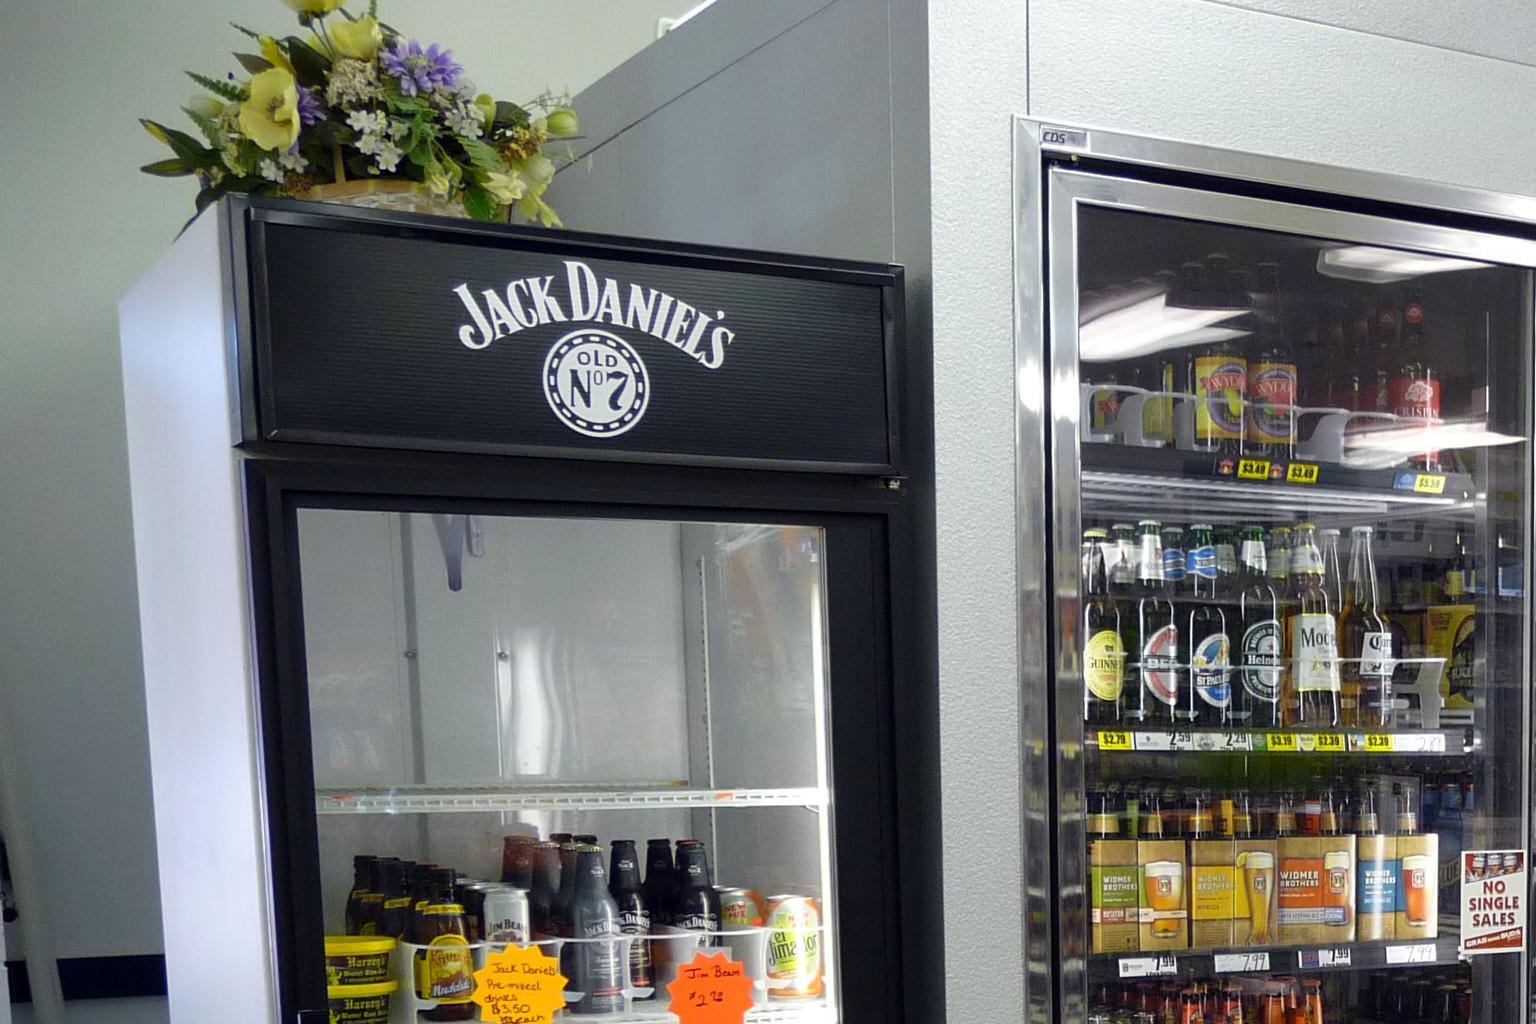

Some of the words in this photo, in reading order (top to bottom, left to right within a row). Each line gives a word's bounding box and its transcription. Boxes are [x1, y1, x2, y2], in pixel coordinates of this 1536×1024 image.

[1042, 131, 1066, 144] CDS
[452, 275, 559, 350] JACK
[562, 260, 735, 370] DANIEL'S
[577, 350, 618, 367] OLD
[1243, 463, 1266, 475] $3.49
[1103, 734, 1127, 745] $2.79
[1270, 736, 1292, 747] $3.19
[1318, 735, 1341, 747] $2.39
[1368, 735, 1390, 747] $2.39
[1280, 870, 1319, 880] WIDMER
[1280, 880, 1319, 888] BROTHERS
[1482, 880, 1506, 894] NO
[1468, 896, 1520, 911] SINGLE
[1472, 912, 1516, 927] SALES
[493, 962, 517, 975] Jack
[686, 967, 709, 979] Jim
[714, 966, 741, 979] Beam
[484, 993, 518, 1004] drinks
